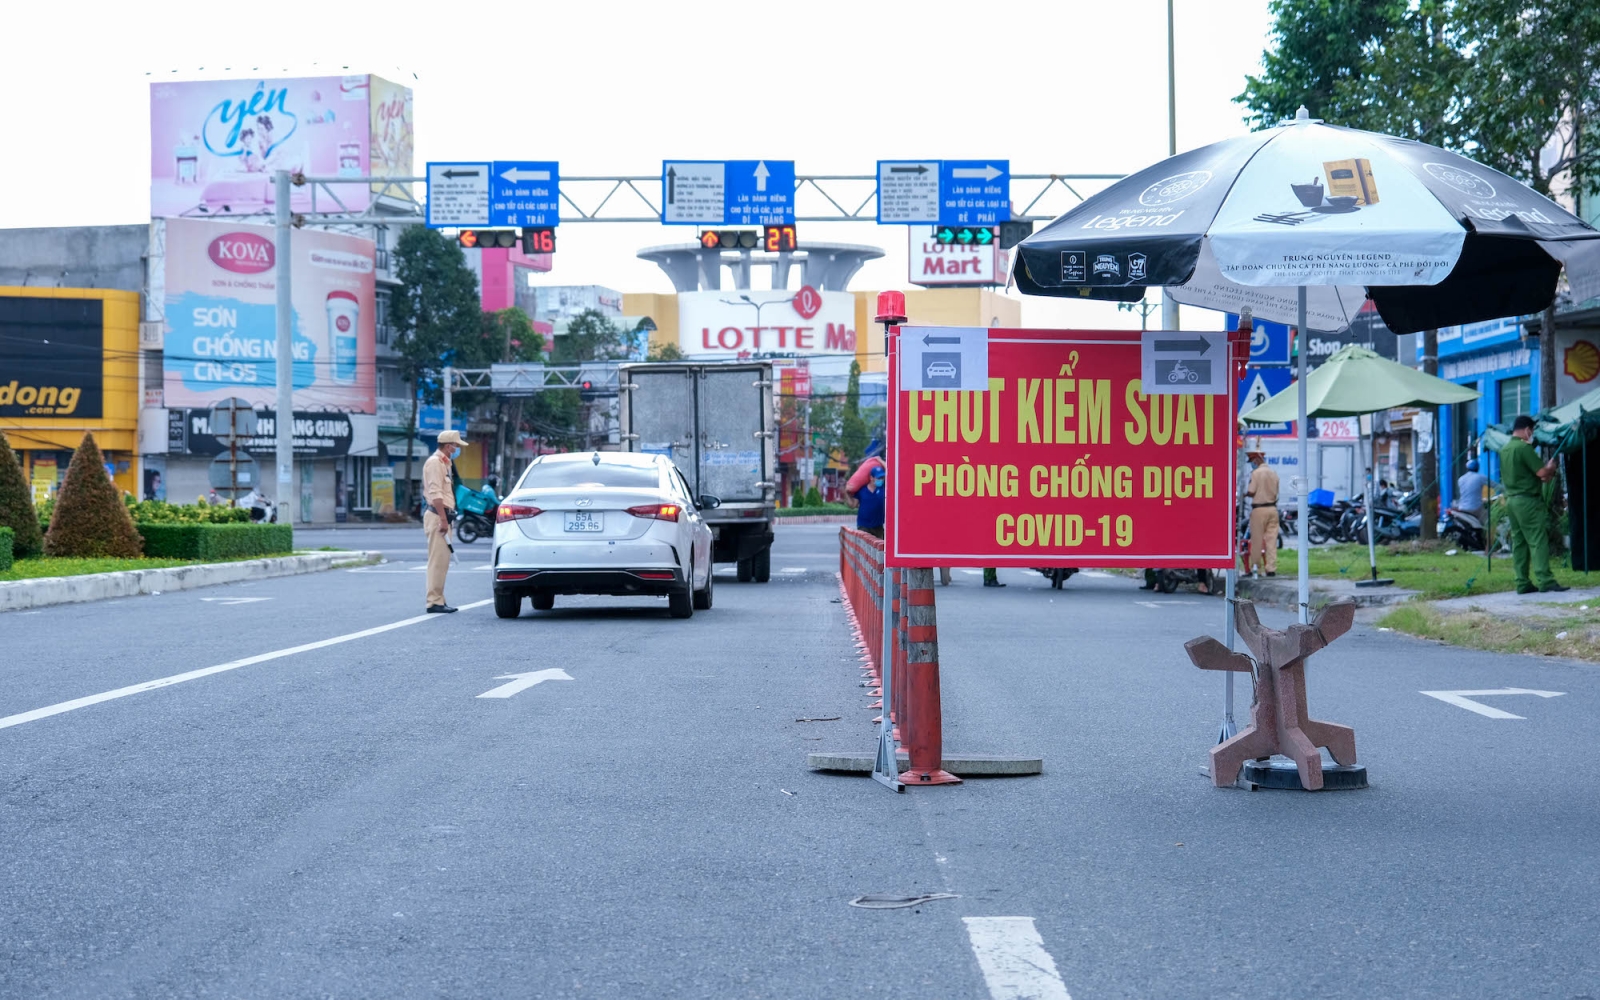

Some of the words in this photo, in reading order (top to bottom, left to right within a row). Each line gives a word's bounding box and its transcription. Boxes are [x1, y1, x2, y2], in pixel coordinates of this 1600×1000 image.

[220, 80, 288, 148] yên
[526, 213, 545, 224] TRÁI
[1081, 211, 1185, 231] Legend
[533, 230, 553, 252] 16
[768, 227, 794, 250] 27
[218, 241, 270, 262] KOVA
[1317, 253, 1353, 261] NGUYÊN
[923, 256, 981, 275] Mart
[193, 305, 237, 328] SƠN
[193, 331, 260, 357] CHỐNG
[264, 338, 309, 360] NNG
[702, 326, 814, 349] LOTTE
[193, 362, 257, 382] CN-05
[1017, 350, 1111, 445] KIỂM
[25, 406, 54, 414] .com
[315, 420, 349, 437] GIANG
[1322, 421, 1351, 437] 20%
[914, 456, 1018, 497] PHÒNG
[1029, 454, 1132, 498] CHỐNG
[1143, 466, 1214, 506] DỊCH
[575, 513, 593, 522] 65A
[995, 513, 1134, 547] COVID-19
